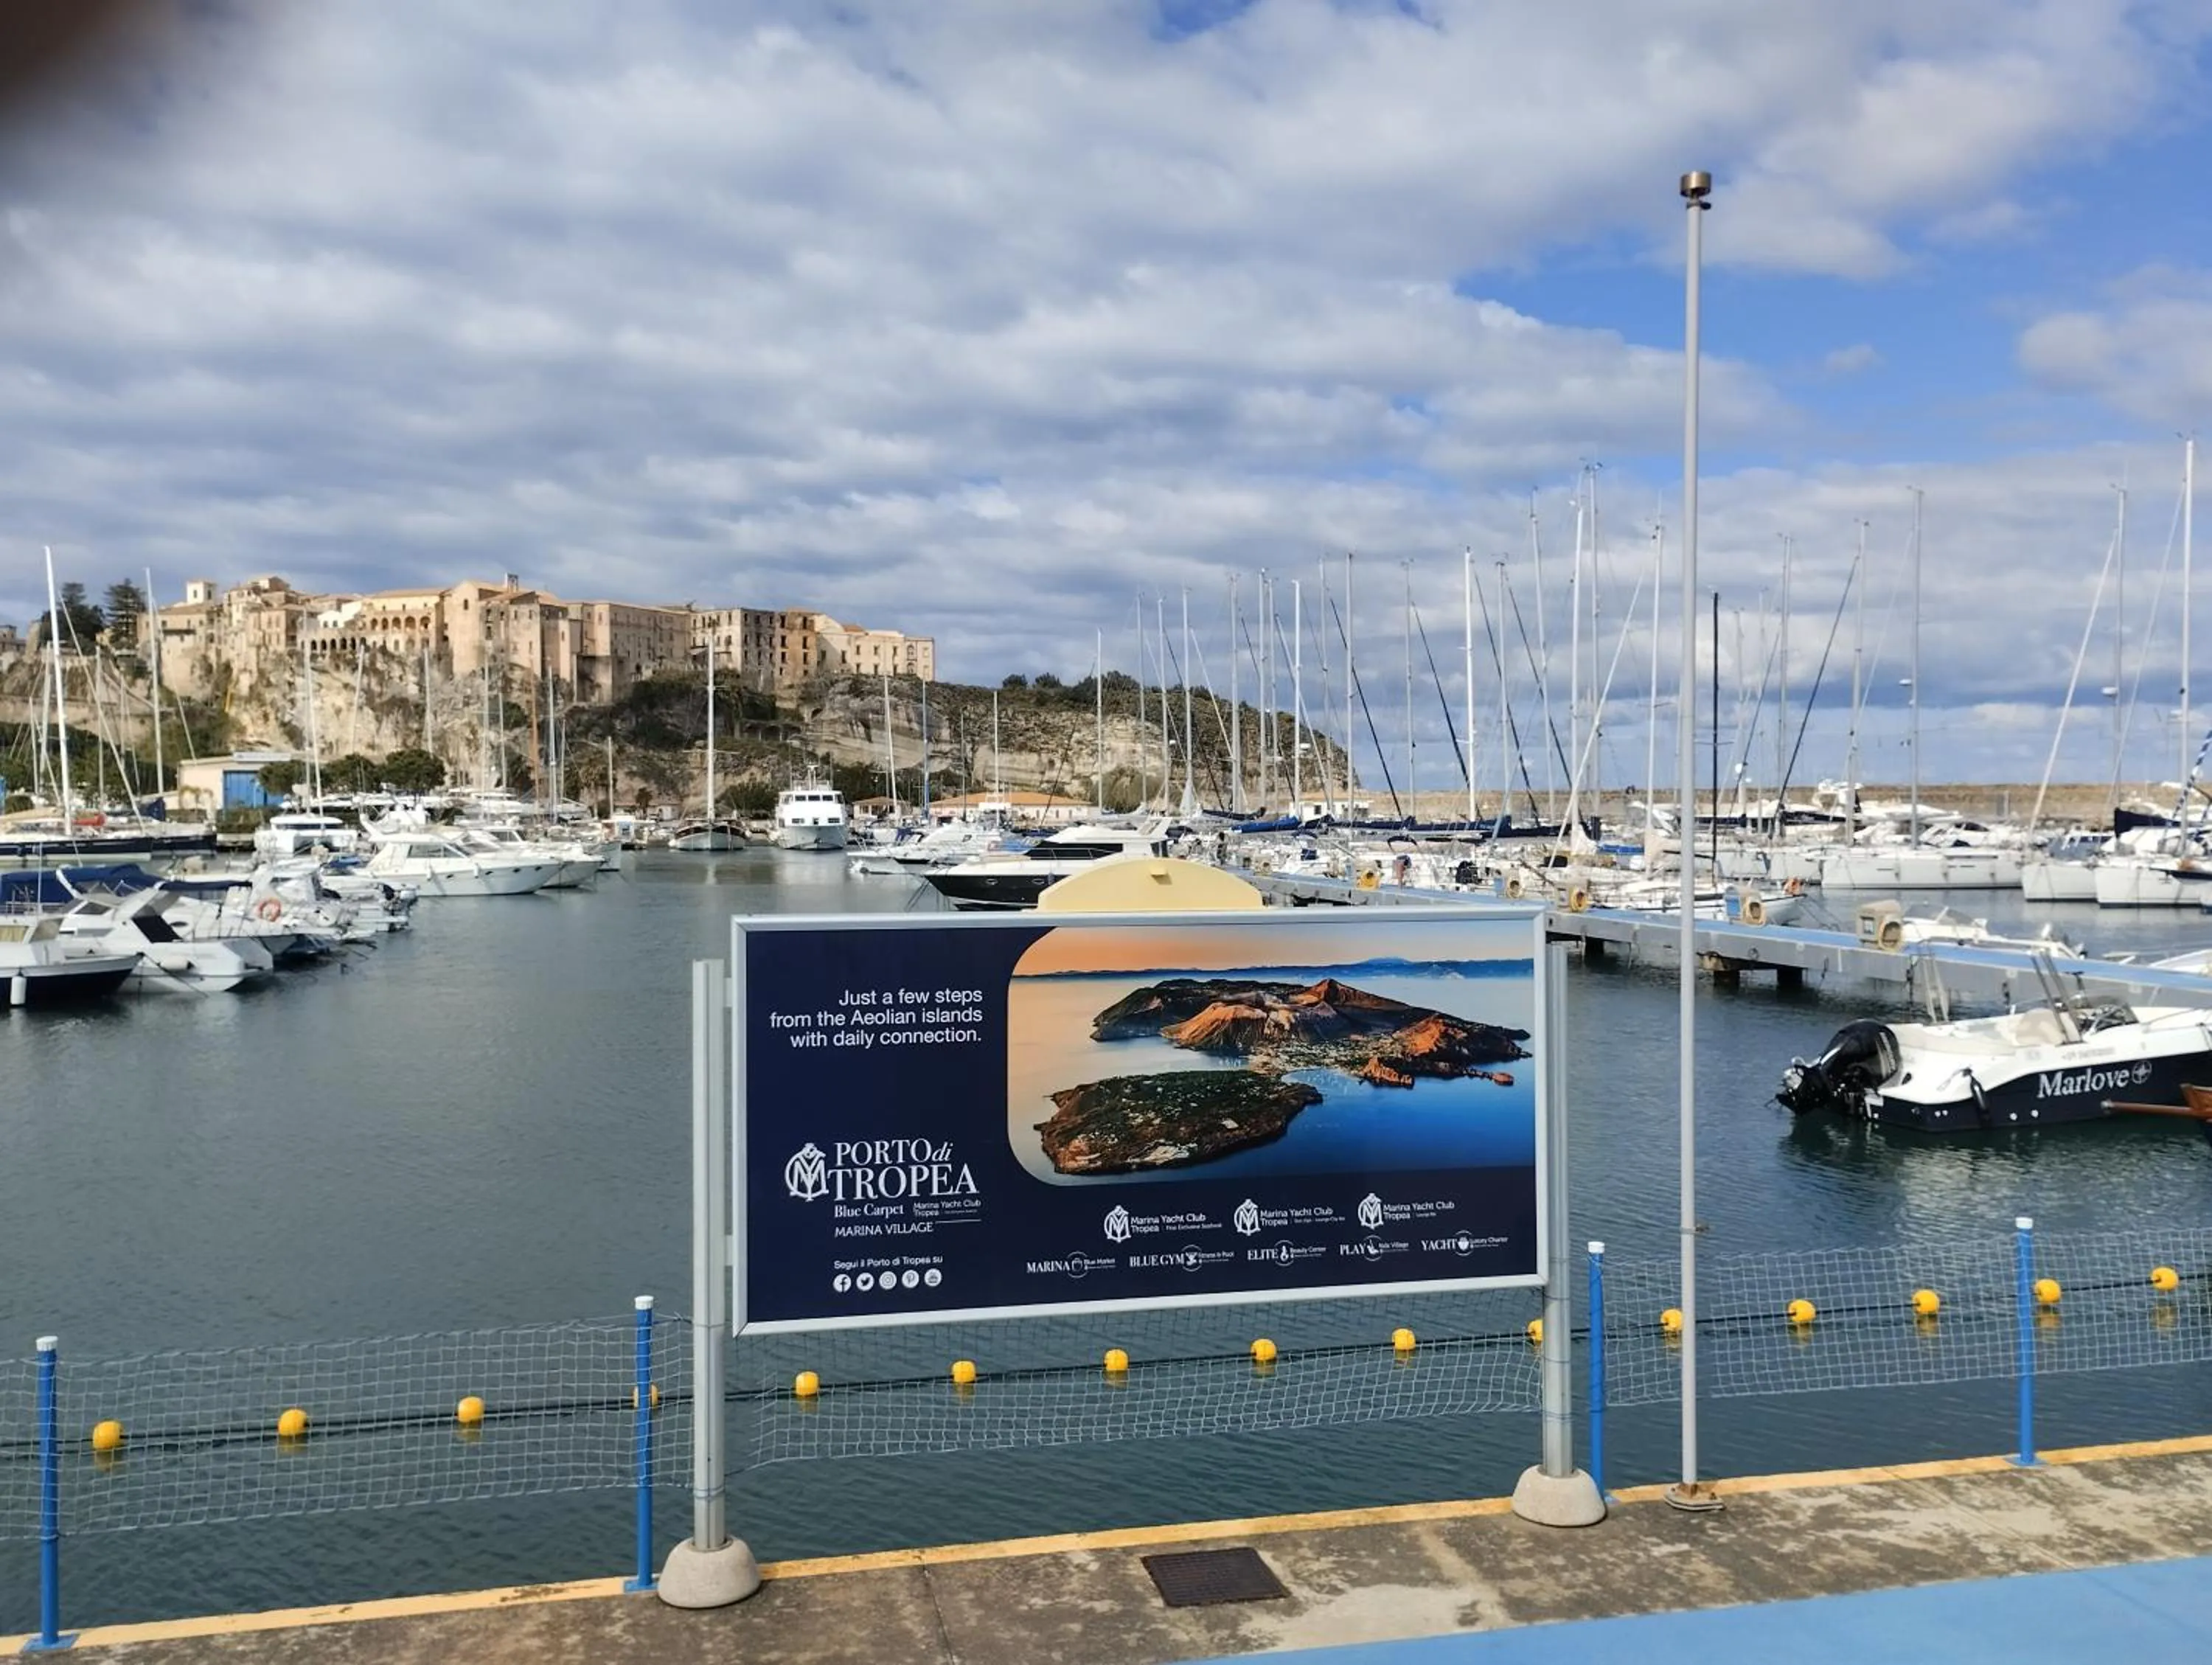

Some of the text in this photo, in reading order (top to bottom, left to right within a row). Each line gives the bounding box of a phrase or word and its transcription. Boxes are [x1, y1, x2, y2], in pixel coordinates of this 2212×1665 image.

[839, 987, 983, 1006] Just a few steps
[770, 1007, 983, 1028] from the Aeolian islands
[790, 1026, 981, 1049] with daily connection.
[2037, 1068, 2130, 1098] Marlove
[834, 1139, 953, 1167] PORTO di
[827, 1163, 980, 1201] TROPEA
[963, 1198, 981, 1207] Club
[1411, 1203, 1434, 1211] Yacht
[1436, 1201, 1455, 1209] Club
[834, 1203, 904, 1219] Blue Carpet
[1289, 1208, 1312, 1216] Yacht
[1313, 1206, 1333, 1216] Club
[1383, 1212, 1411, 1220] Tropea
[1130, 1213, 1206, 1225] Marina Yacht Club
[1260, 1217, 1288, 1226] Tropea
[834, 1222, 933, 1237] MARINA VILLAGE
[1130, 1225, 1160, 1233] Tropea
[1340, 1244, 1366, 1255] PLAY
[1421, 1239, 1458, 1251] YACHT
[1247, 1248, 1279, 1260] ELITE
[834, 1260, 859, 1270] Segui
[867, 1258, 891, 1267] Porto
[892, 1256, 900, 1265] di
[902, 1256, 931, 1265] Tropea
[1026, 1261, 1070, 1273] MARINA
[1130, 1255, 1159, 1268] BLUE
[1160, 1254, 1184, 1265] GYM
